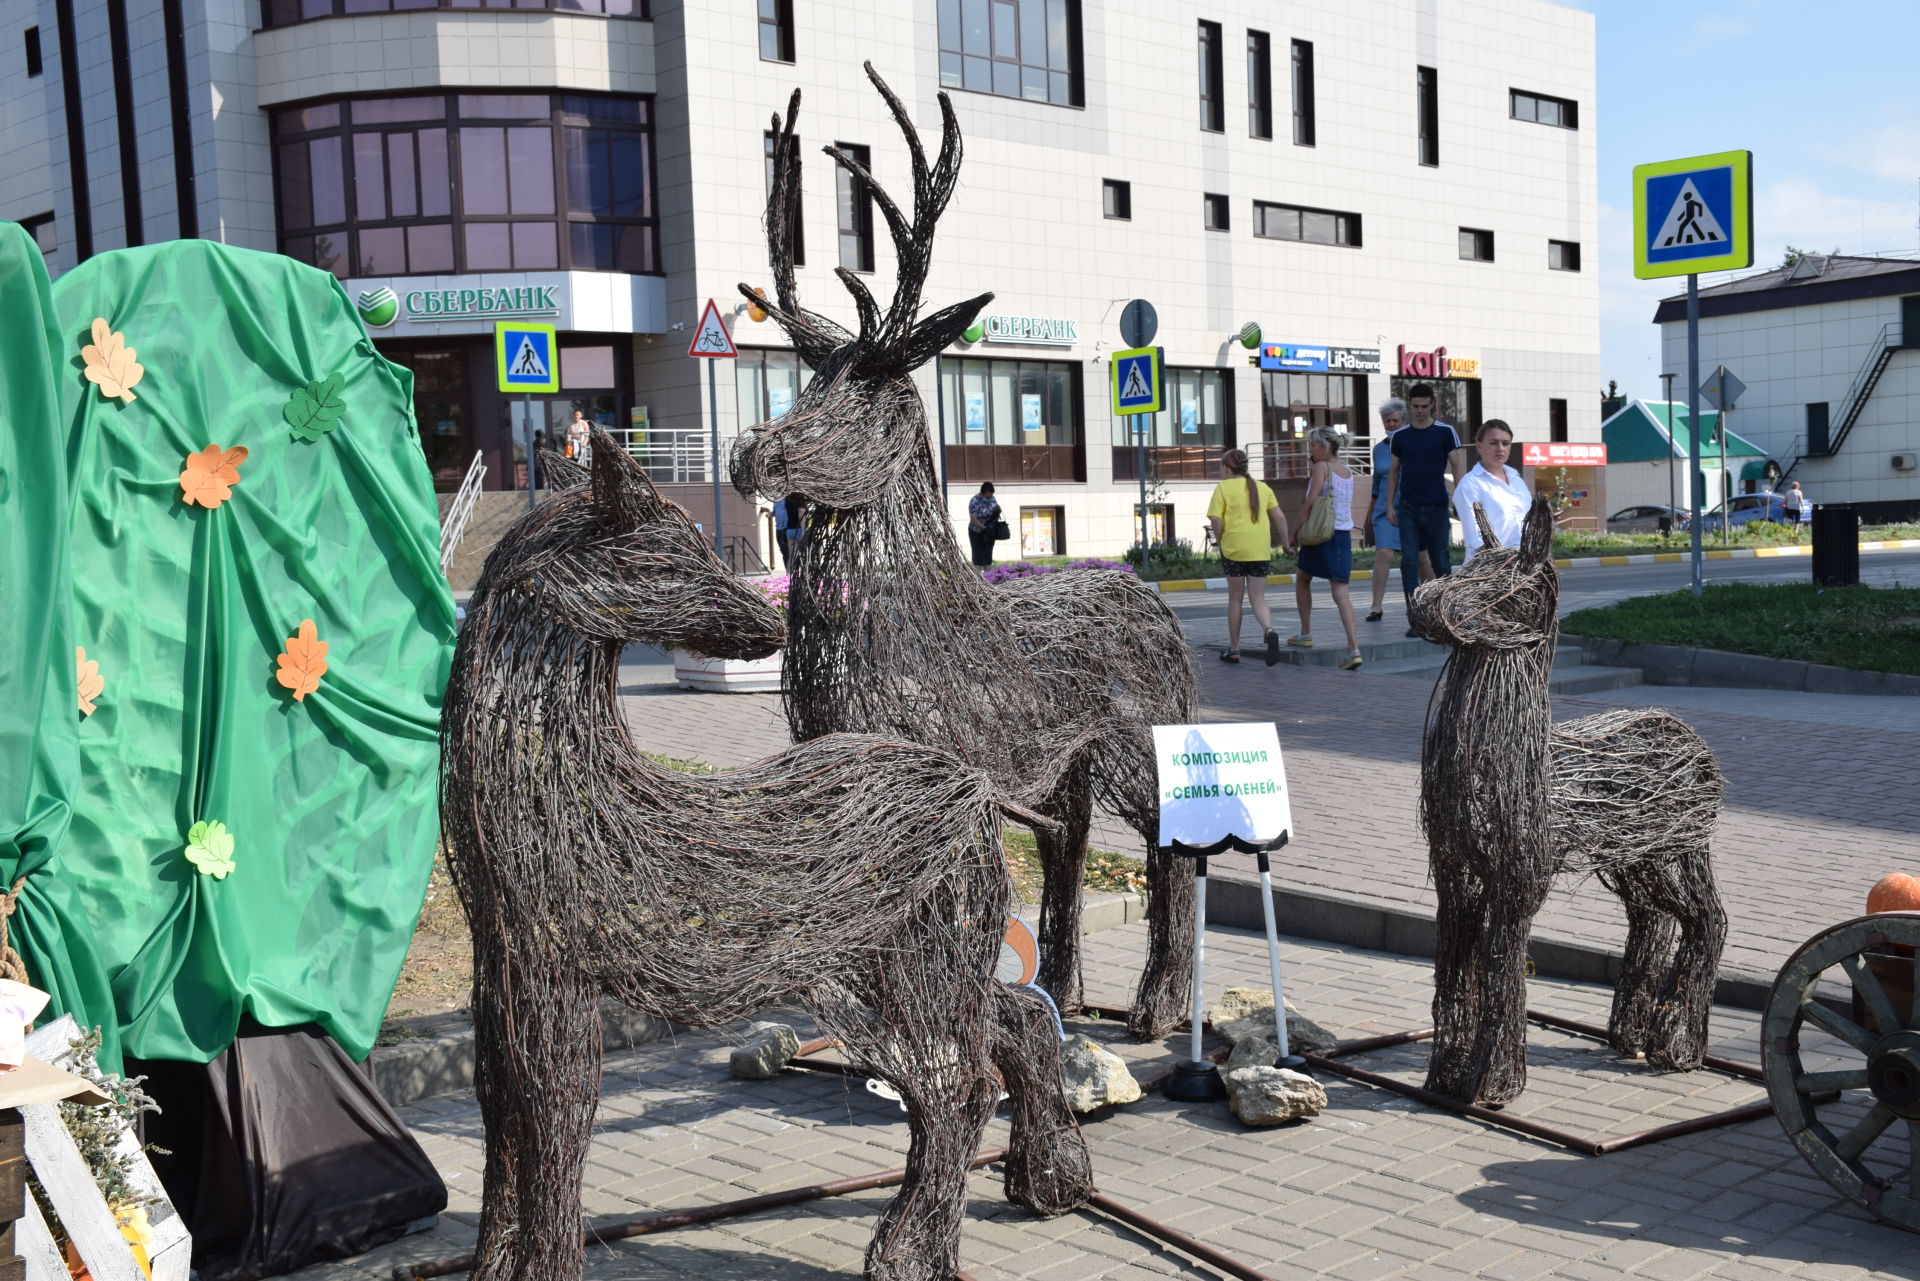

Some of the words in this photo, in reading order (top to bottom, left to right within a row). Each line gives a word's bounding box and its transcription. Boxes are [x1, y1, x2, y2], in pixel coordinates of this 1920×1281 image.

[406, 285, 559, 315] СБЕРБАНК
[987, 315, 1078, 339] СБЕРБАНК
[1328, 350, 1355, 368] LiRa
[1399, 344, 1448, 377] kari
[1172, 750, 1268, 766] КОМПОЗИЦИЯ
[1165, 784, 1219, 799] «СЕМЬЯ
[1224, 779, 1282, 797] ОЛЕНЕЙ»
